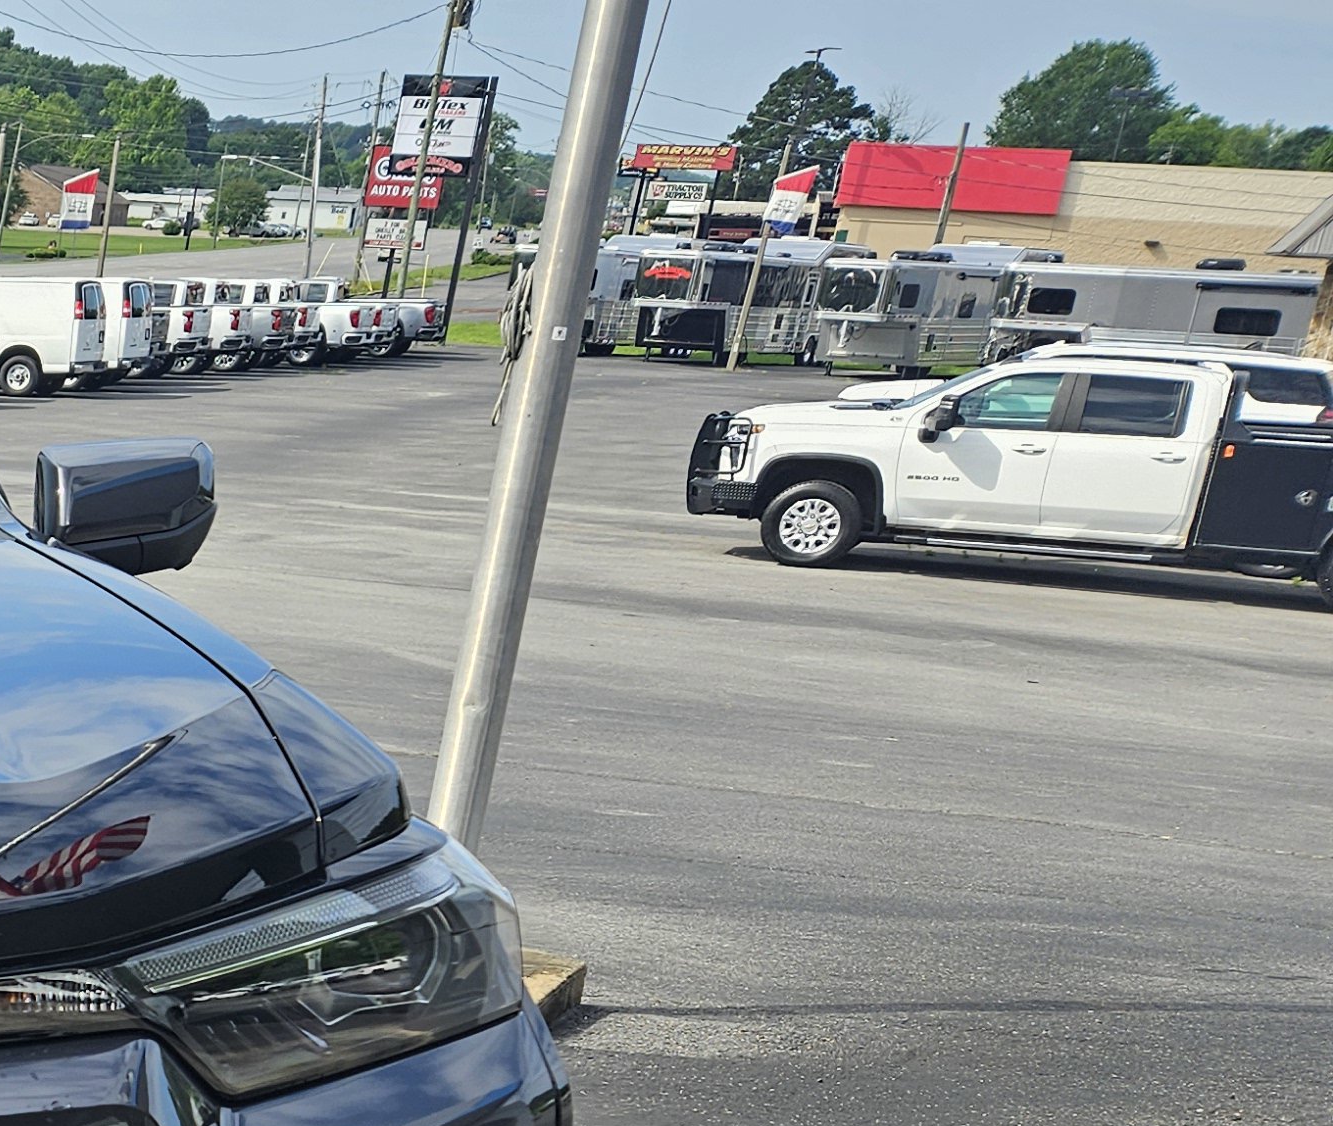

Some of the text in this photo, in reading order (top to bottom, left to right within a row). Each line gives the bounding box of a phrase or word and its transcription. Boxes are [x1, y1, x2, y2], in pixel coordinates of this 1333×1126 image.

[640, 145, 732, 156] MARVIN'S
[371, 185, 400, 196] AUTO
[666, 184, 704, 192] TRACTOR
[664, 191, 691, 199] SUPPLY
